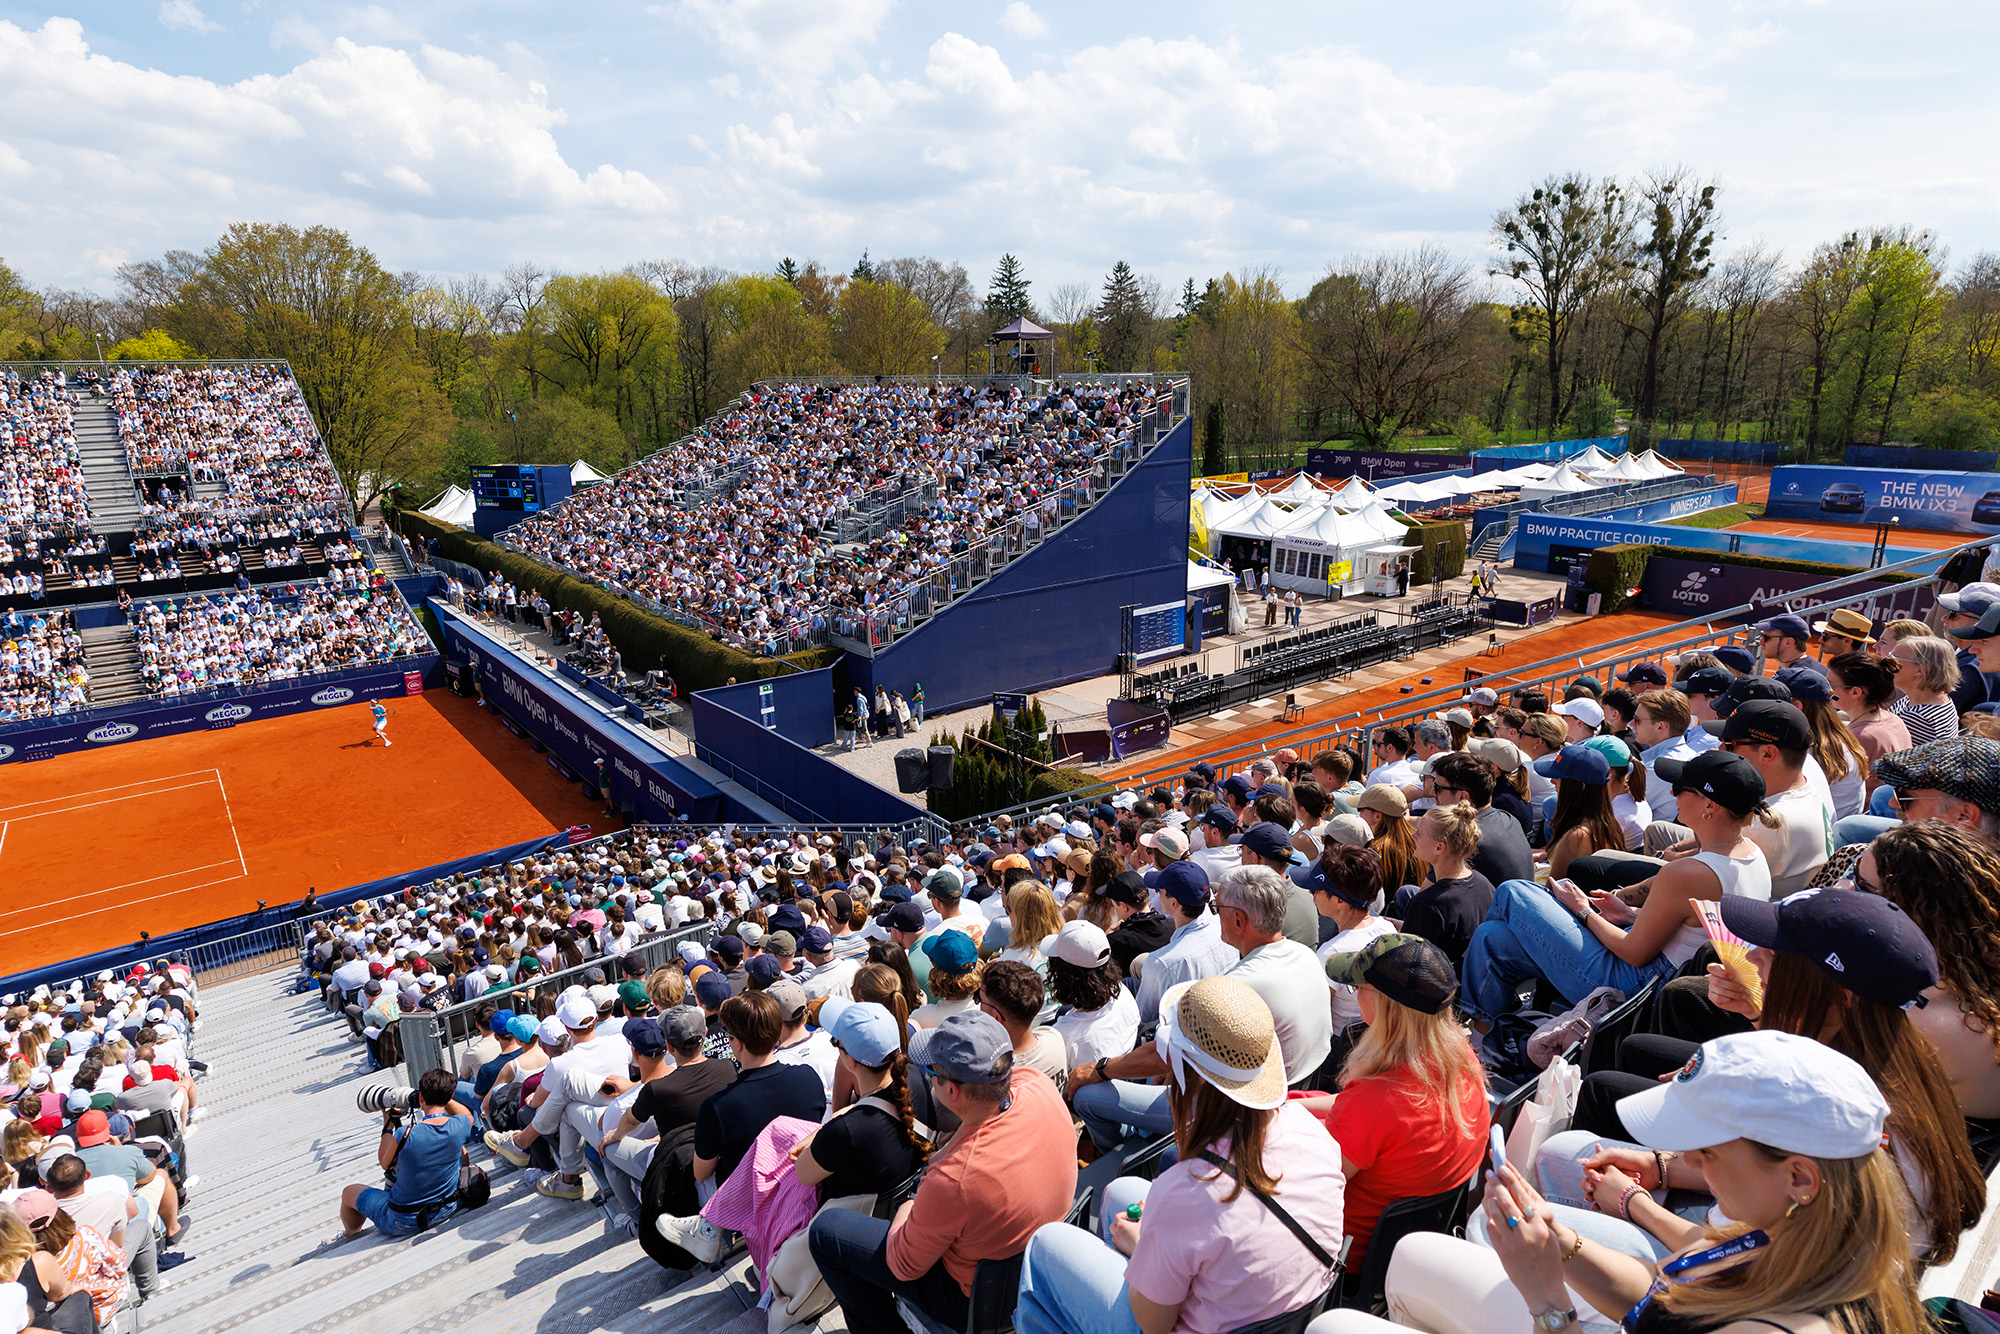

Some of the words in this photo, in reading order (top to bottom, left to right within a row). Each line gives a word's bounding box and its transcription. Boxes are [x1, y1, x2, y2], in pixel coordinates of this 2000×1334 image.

[1334, 455, 1351, 464] joyn
[1361, 456, 1382, 467] BMW
[1384, 458, 1406, 468] Open
[1880, 481, 1917, 496] THE
[1921, 484, 1964, 498] NEW
[1670, 499, 1698, 514] WINNER'S
[1699, 494, 1712, 508] CAR
[1880, 496, 1926, 510] BMW
[1928, 498, 1958, 512] iX3
[1526, 524, 1557, 537] BMW
[1559, 526, 1621, 543] PRACTICE
[1624, 533, 1672, 546] COURT
[1294, 539, 1324, 547] DUNLOP
[1672, 588, 1710, 604] LOTTO
[317, 690, 348, 702] MEGGLE
[502, 672, 523, 705] BMW
[524, 689, 548, 724] Open
[212, 708, 246, 719] MEGGLE
[94, 726, 132, 739] MEGGLE
[614, 756, 633, 780] Allianz
[648, 780, 674, 809] RADO
[1707, 1250, 1725, 1260] Open
[1725, 1244, 1742, 1256] BMW
